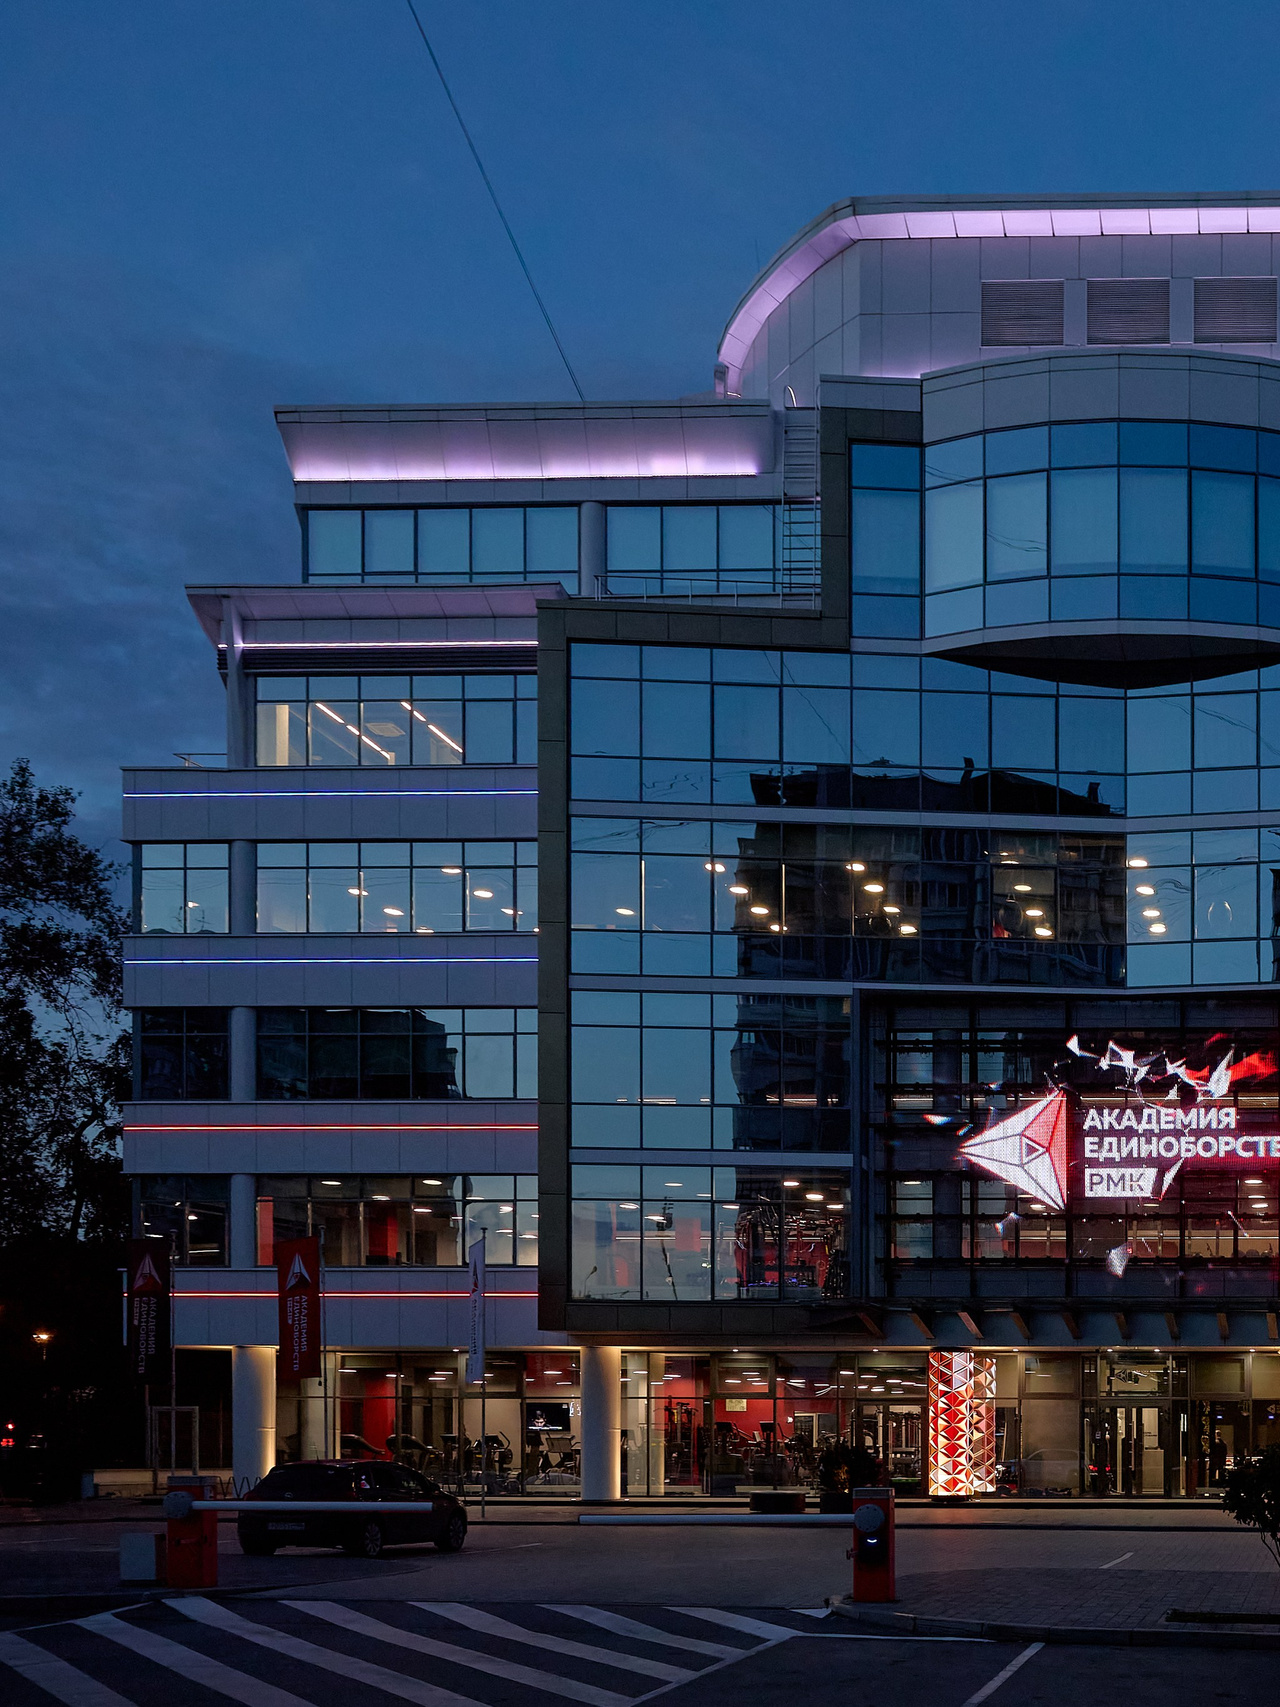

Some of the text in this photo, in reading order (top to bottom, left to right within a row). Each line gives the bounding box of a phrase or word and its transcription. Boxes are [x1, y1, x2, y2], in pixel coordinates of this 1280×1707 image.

[1083, 1108, 1236, 1133] АКАДЕМИЯ
[1088, 1172, 1145, 1192] РМК
[147, 1296, 158, 1355] АКАДЕМИЯ
[300, 1295, 308, 1352] АКАДЕМИЯ
